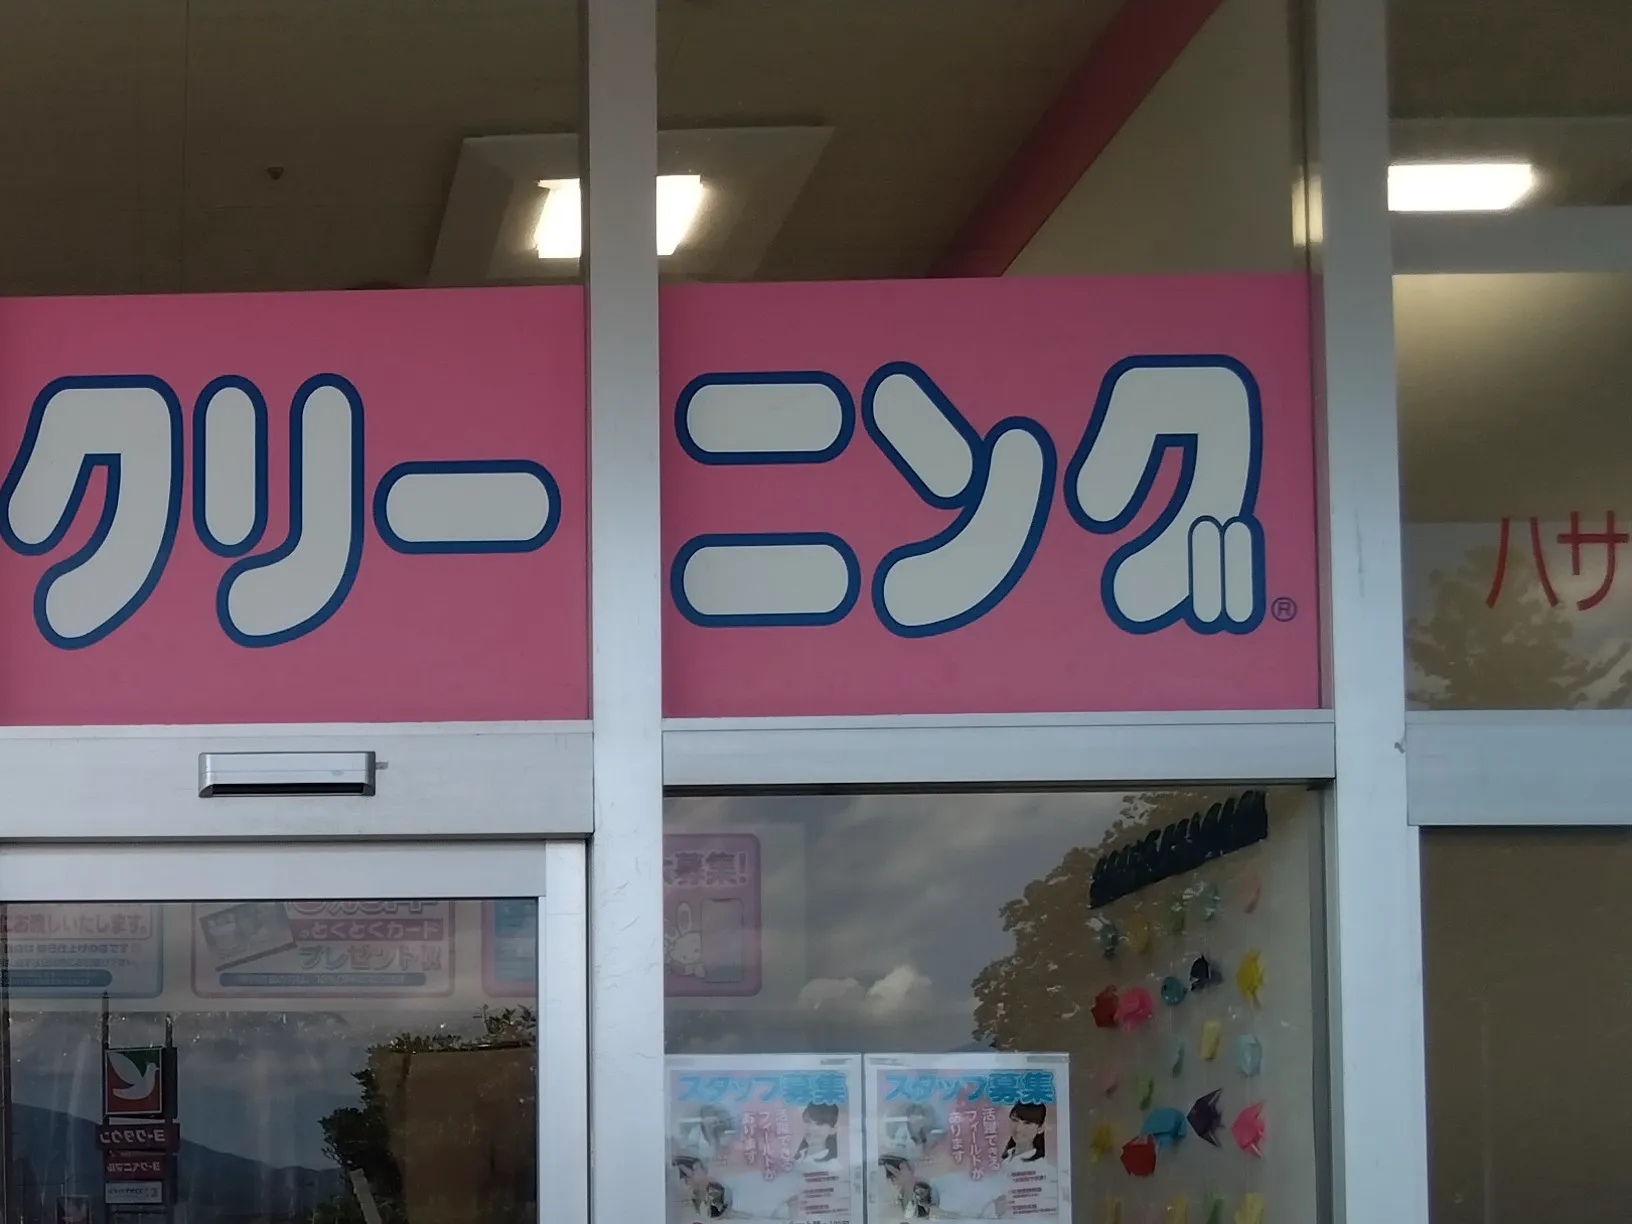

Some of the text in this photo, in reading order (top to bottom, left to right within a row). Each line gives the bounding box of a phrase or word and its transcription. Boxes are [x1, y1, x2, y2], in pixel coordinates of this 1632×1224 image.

[678, 1072, 848, 1105] スタッフ募集
[884, 1071, 1057, 1105] スタッフ募集
